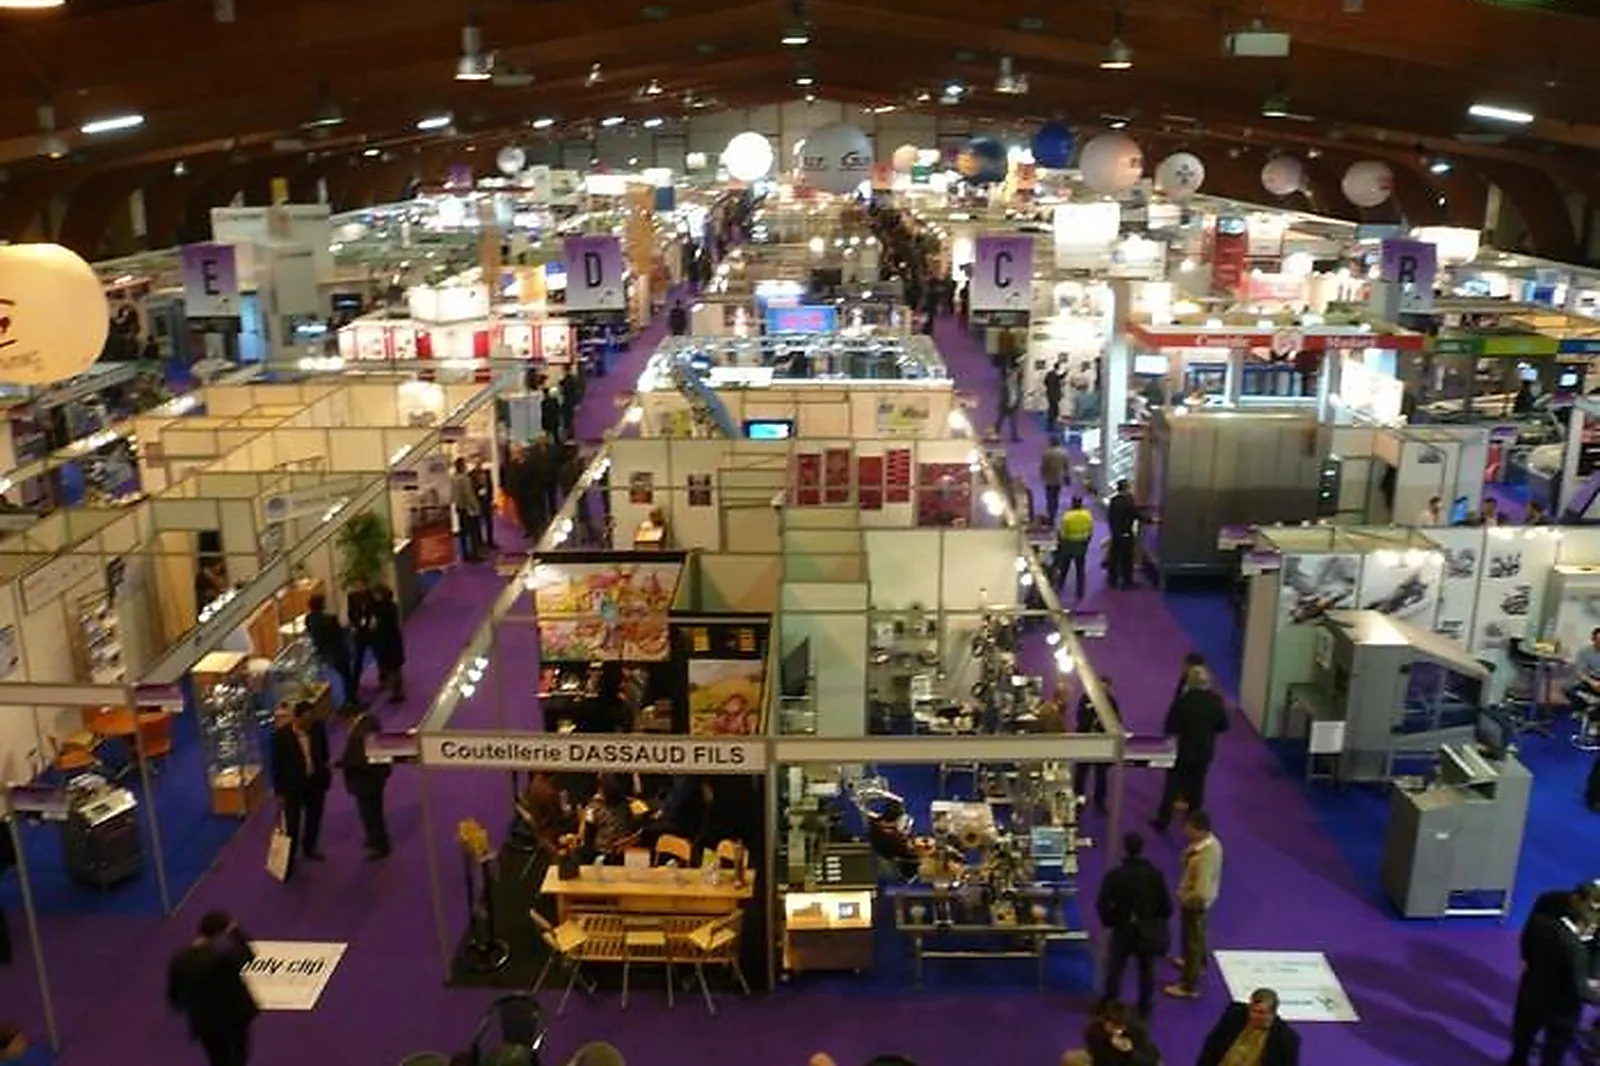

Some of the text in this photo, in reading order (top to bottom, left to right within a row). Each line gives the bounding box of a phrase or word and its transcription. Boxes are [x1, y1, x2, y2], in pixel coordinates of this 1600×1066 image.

[202, 259, 220, 296] E
[584, 251, 603, 289] D
[995, 251, 1013, 289] C
[440, 740, 746, 764] Coutellerie DASSAUD FILS
